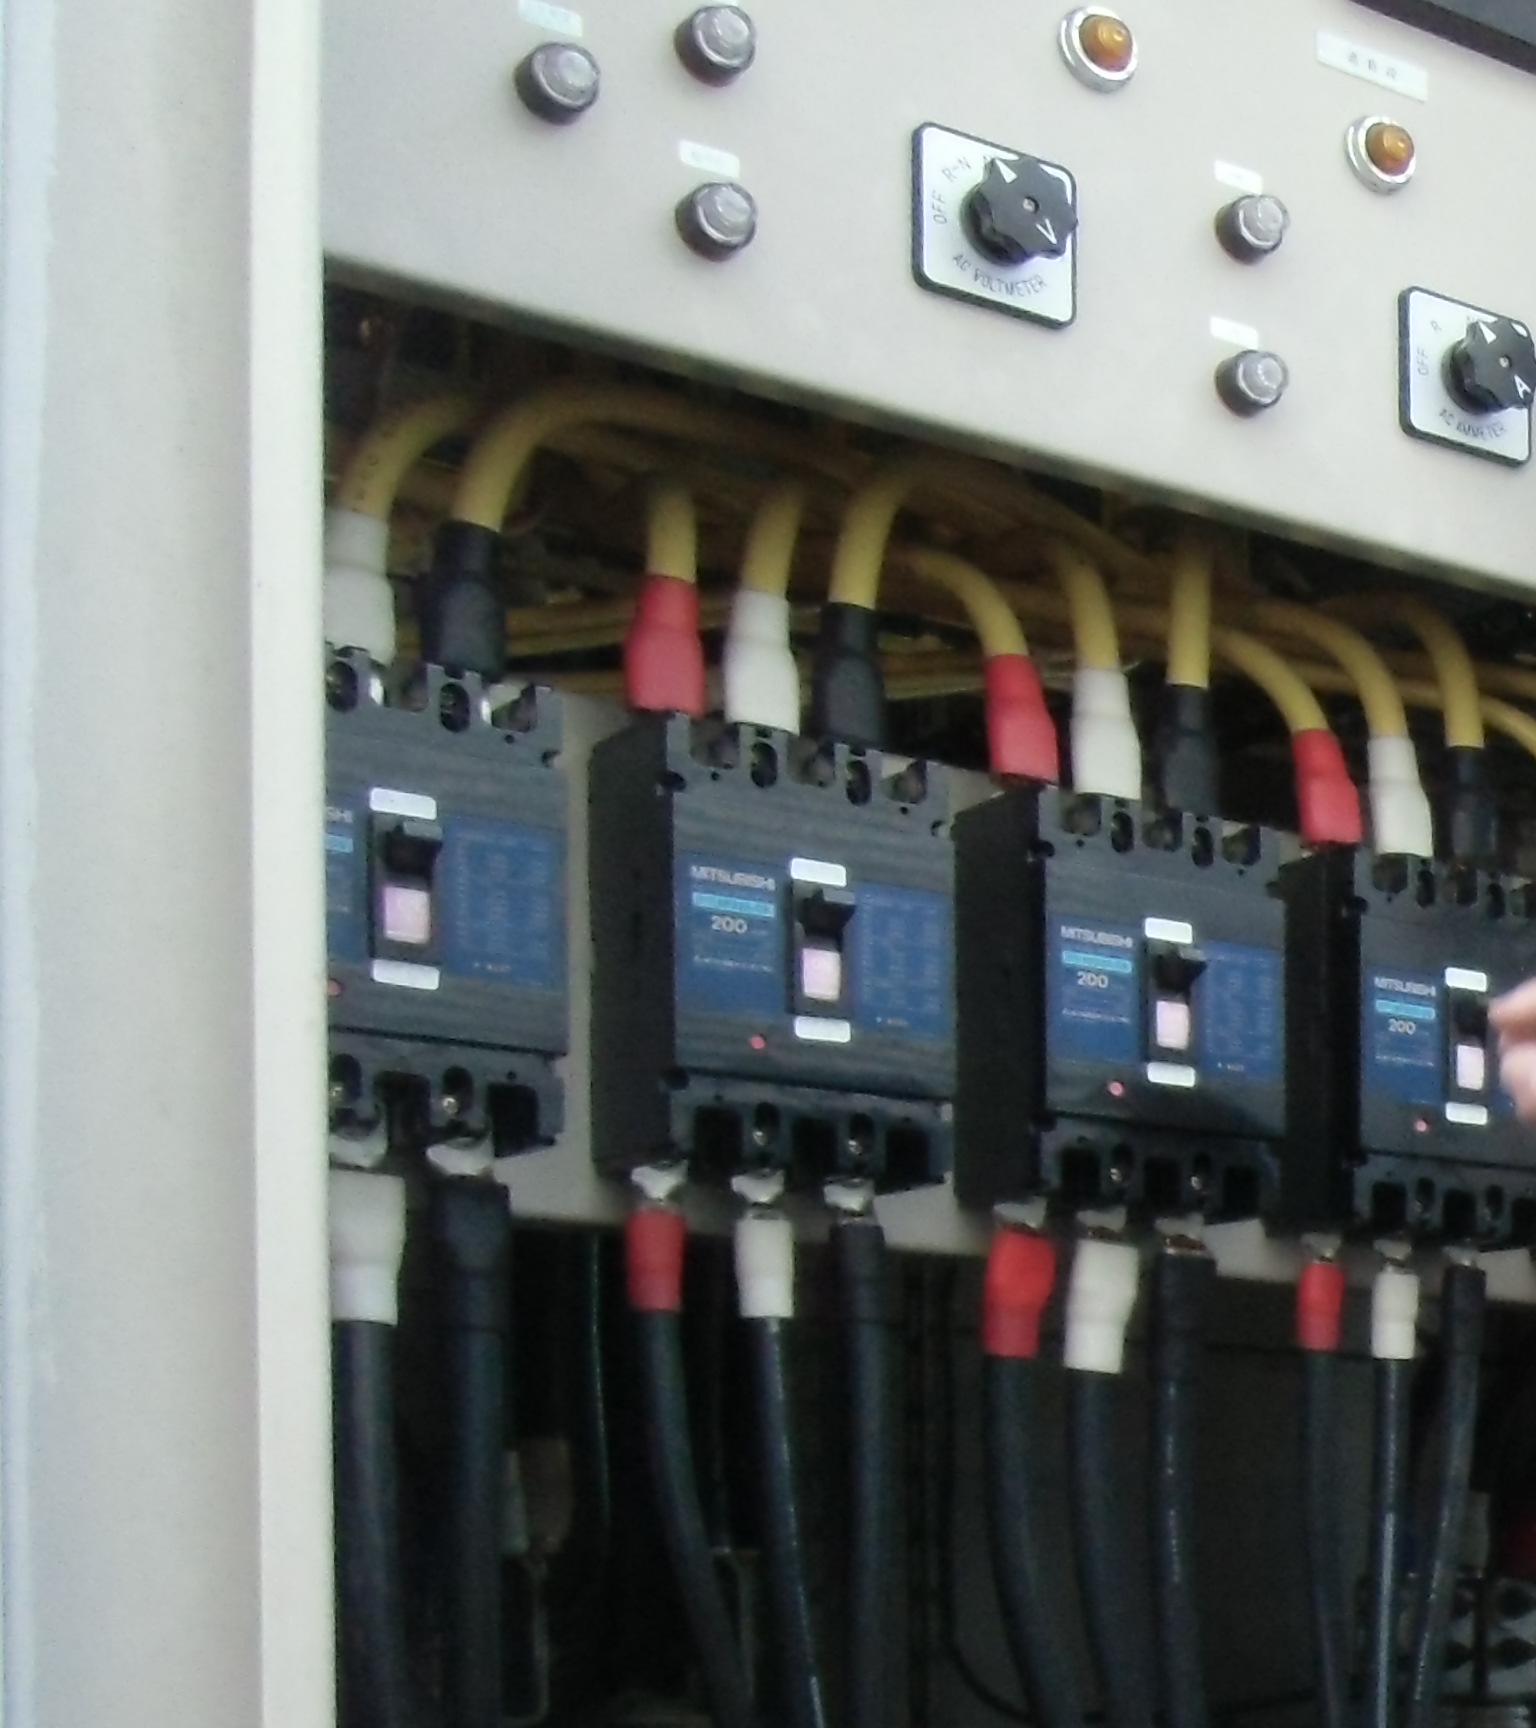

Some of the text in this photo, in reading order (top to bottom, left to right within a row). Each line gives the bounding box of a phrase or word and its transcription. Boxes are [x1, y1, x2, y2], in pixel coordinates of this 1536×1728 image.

[933, 190, 947, 224] OFF
[973, 265, 1048, 297] VOLTMETER
[1417, 346, 1429, 376] OFF
[691, 865, 776, 891] MITSUBISHI
[711, 915, 748, 934] 200
[1060, 925, 1134, 948] MITSUBISHI
[1077, 971, 1109, 988] 200
[1374, 976, 1437, 998] MITSUBISHI
[1388, 1018, 1417, 1035] 200
